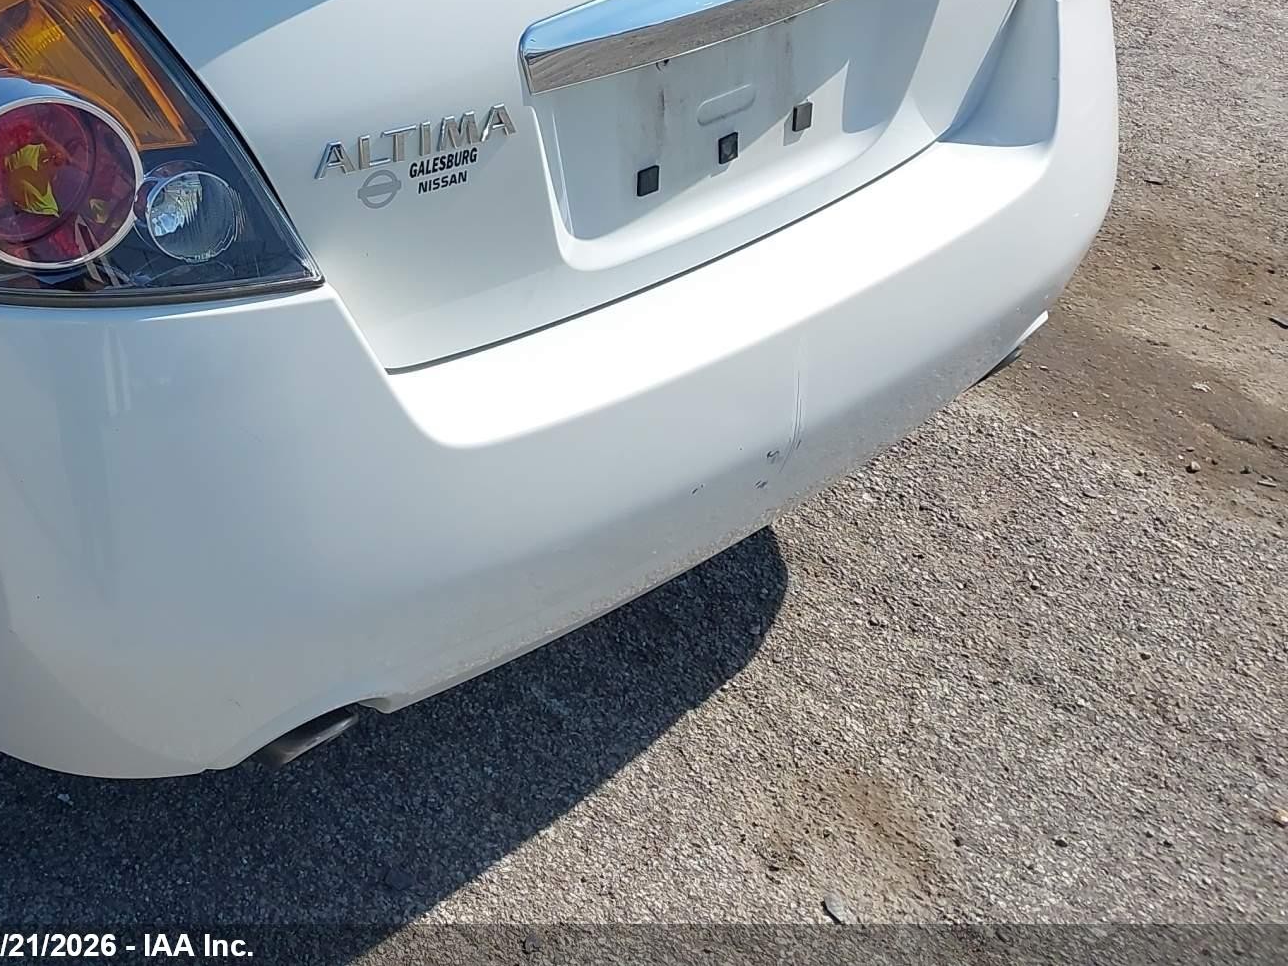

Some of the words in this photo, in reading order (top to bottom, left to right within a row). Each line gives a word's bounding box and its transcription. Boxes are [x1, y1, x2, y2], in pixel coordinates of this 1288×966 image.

[314, 102, 516, 180] ALTIMA
[409, 147, 478, 178] GALESBURG
[417, 171, 468, 194] NISSAN
